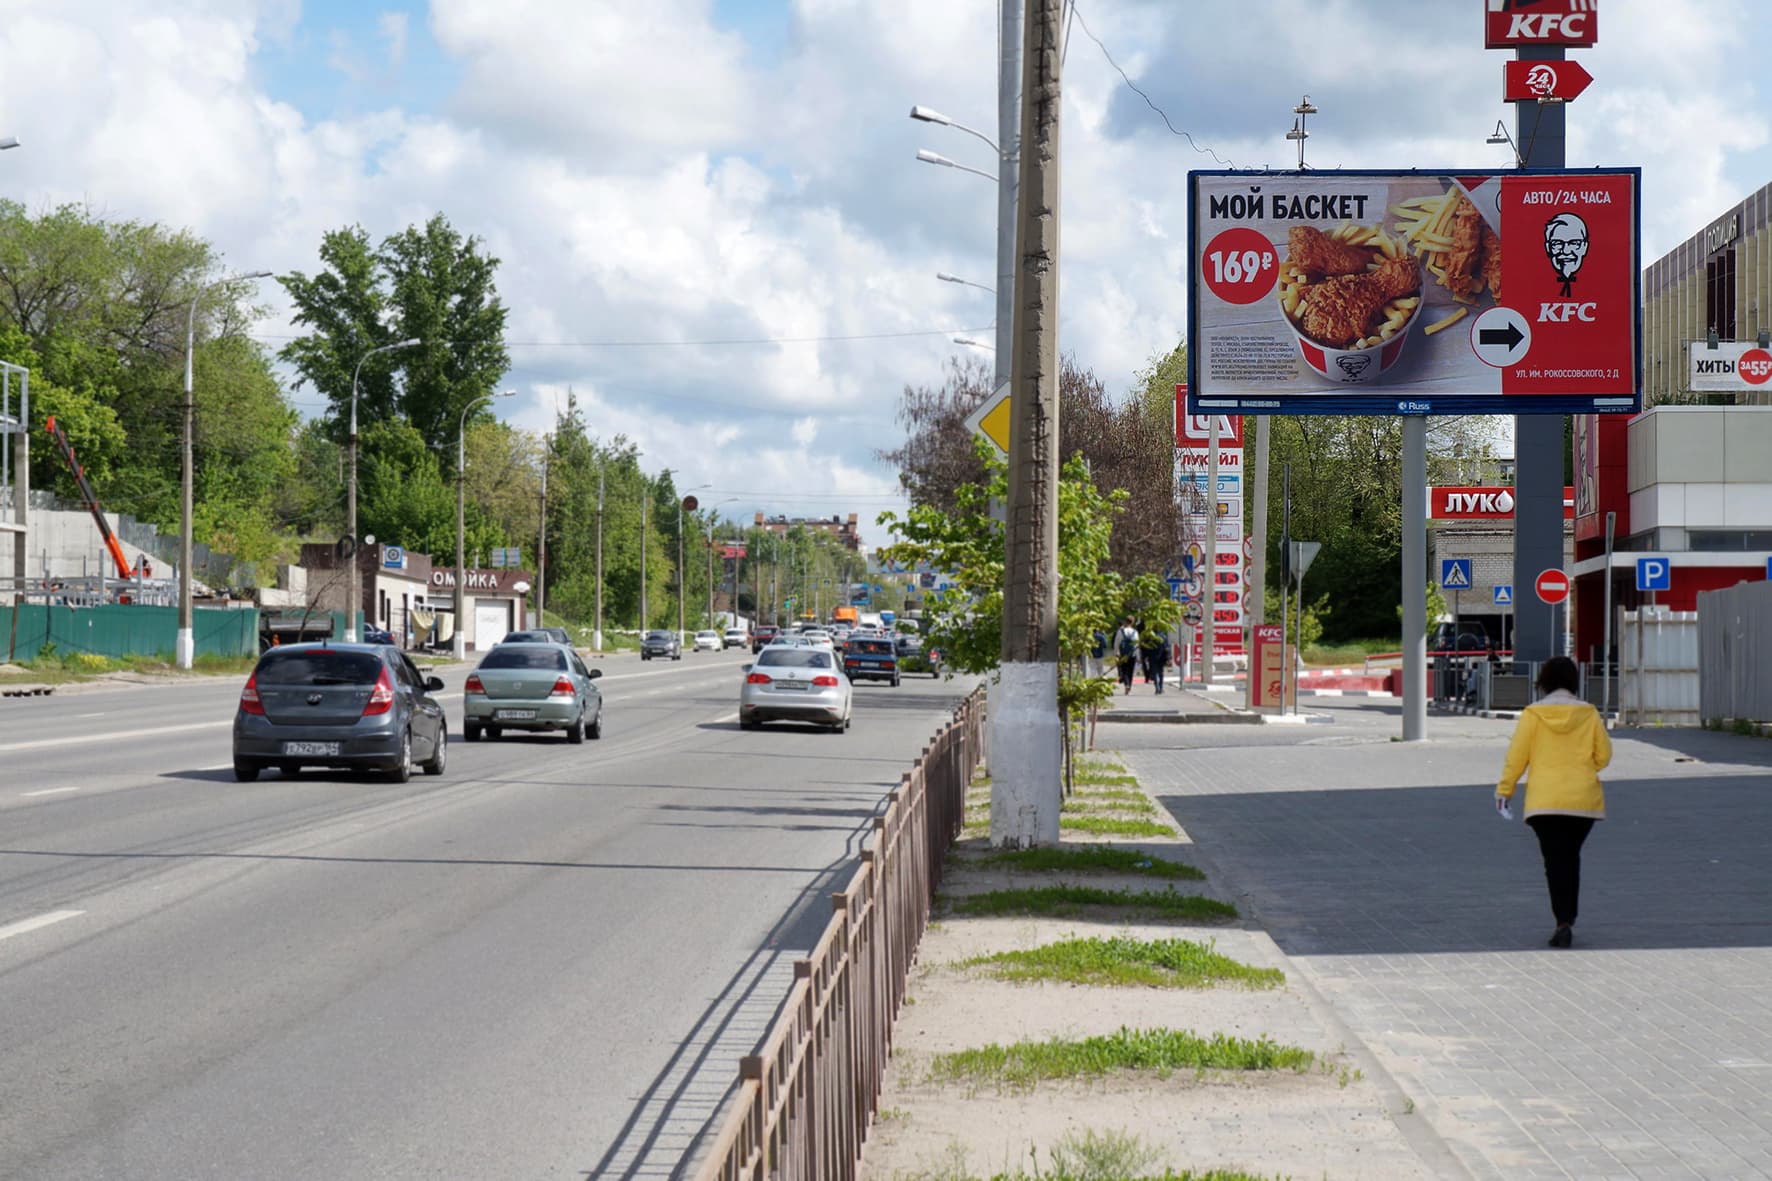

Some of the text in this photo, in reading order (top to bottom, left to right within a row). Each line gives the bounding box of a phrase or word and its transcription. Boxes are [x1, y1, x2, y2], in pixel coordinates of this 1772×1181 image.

[1506, 13, 1586, 38] KFC
[1526, 72, 1549, 85] 24
[1210, 186, 1369, 220] МОЙ БАСКЕТ
[1522, 190, 1612, 206] АВТО/24 ЧАСА
[1536, 302, 1598, 323] KFC
[1515, 369, 1619, 379] УЛ. ИМ. РОКОССОВСКОГО, 2 Д
[1696, 360, 1735, 374] ХИТЫ
[1409, 401, 1430, 411] Russ
[1181, 452, 1239, 465] ЛУКЙЛ
[1444, 489, 1514, 513] ЛУКО
[430, 570, 498, 588] ОМЙКА
[1258, 628, 1281, 637] KFC
